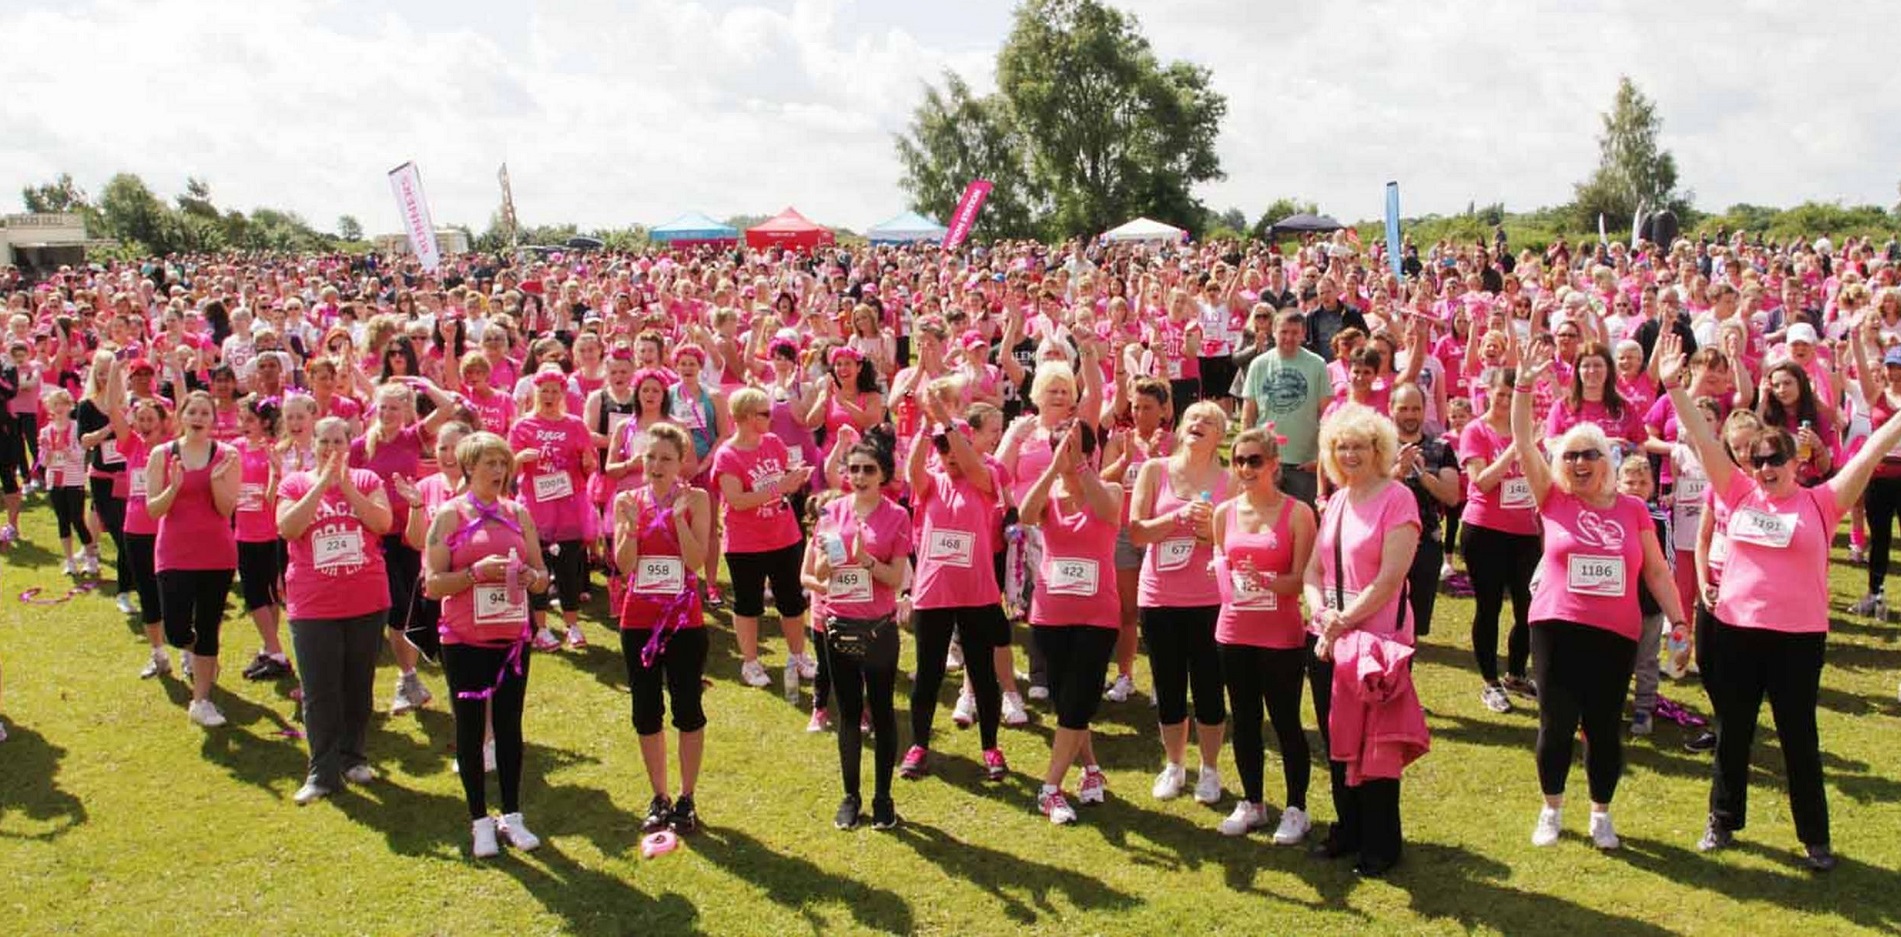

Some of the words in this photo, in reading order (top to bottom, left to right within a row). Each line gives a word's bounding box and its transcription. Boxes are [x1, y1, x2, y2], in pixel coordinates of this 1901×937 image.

[1753, 516, 1781, 531] 1191
[326, 540, 347, 551] 224
[939, 538, 961, 550] 468
[647, 564, 670, 576] 958
[1062, 566, 1085, 578] 422
[1581, 565, 1613, 577] 1186
[837, 573, 858, 585] 469
[489, 592, 506, 604] 94
